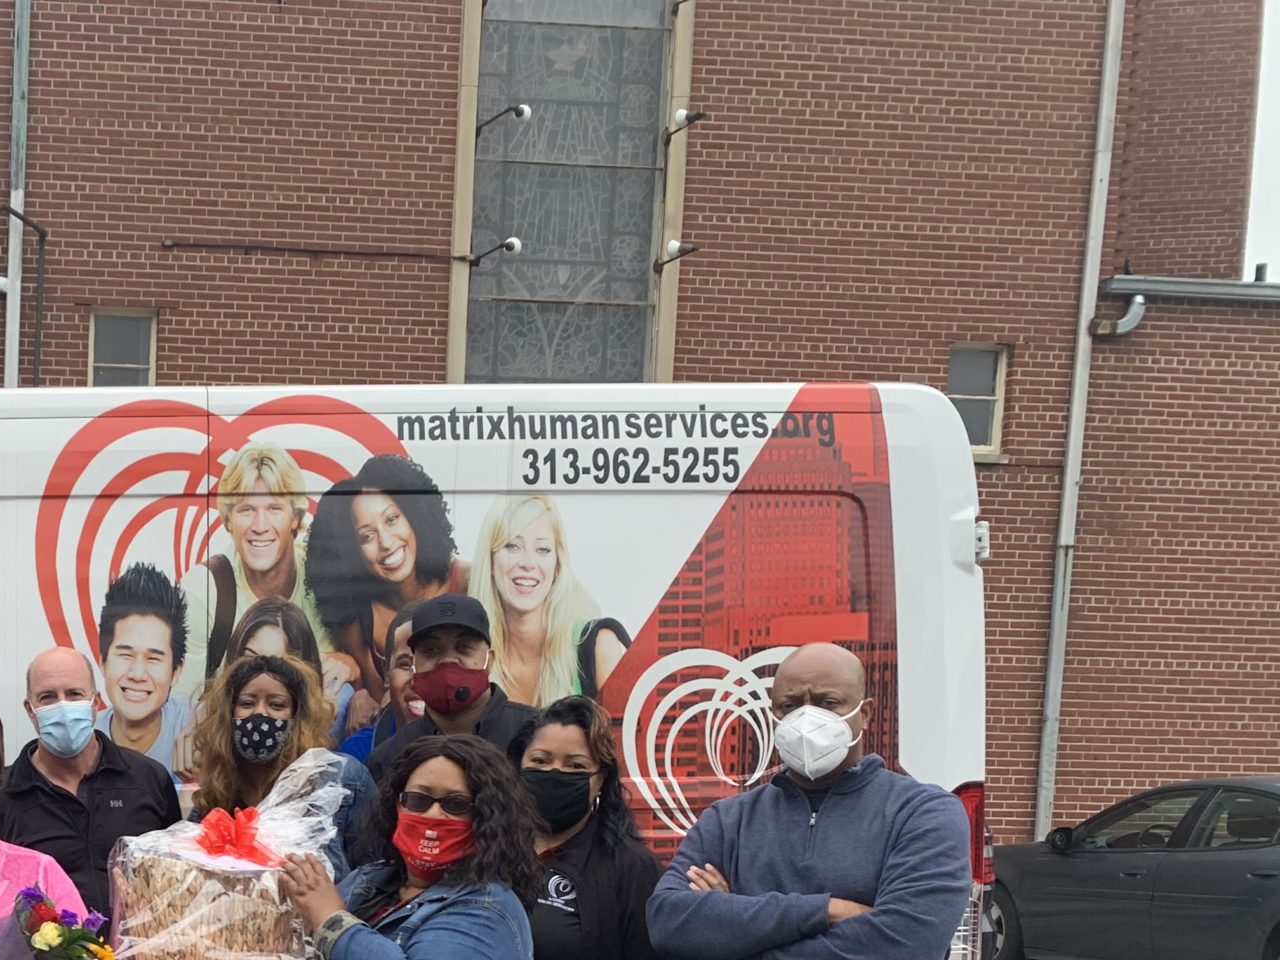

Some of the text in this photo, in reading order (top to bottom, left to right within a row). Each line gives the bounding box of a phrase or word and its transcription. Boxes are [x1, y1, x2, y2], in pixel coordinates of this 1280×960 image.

[522, 446, 740, 485] 313-962-5255
[420, 839, 440, 848] KEEP
[418, 845, 440, 855] CALM
